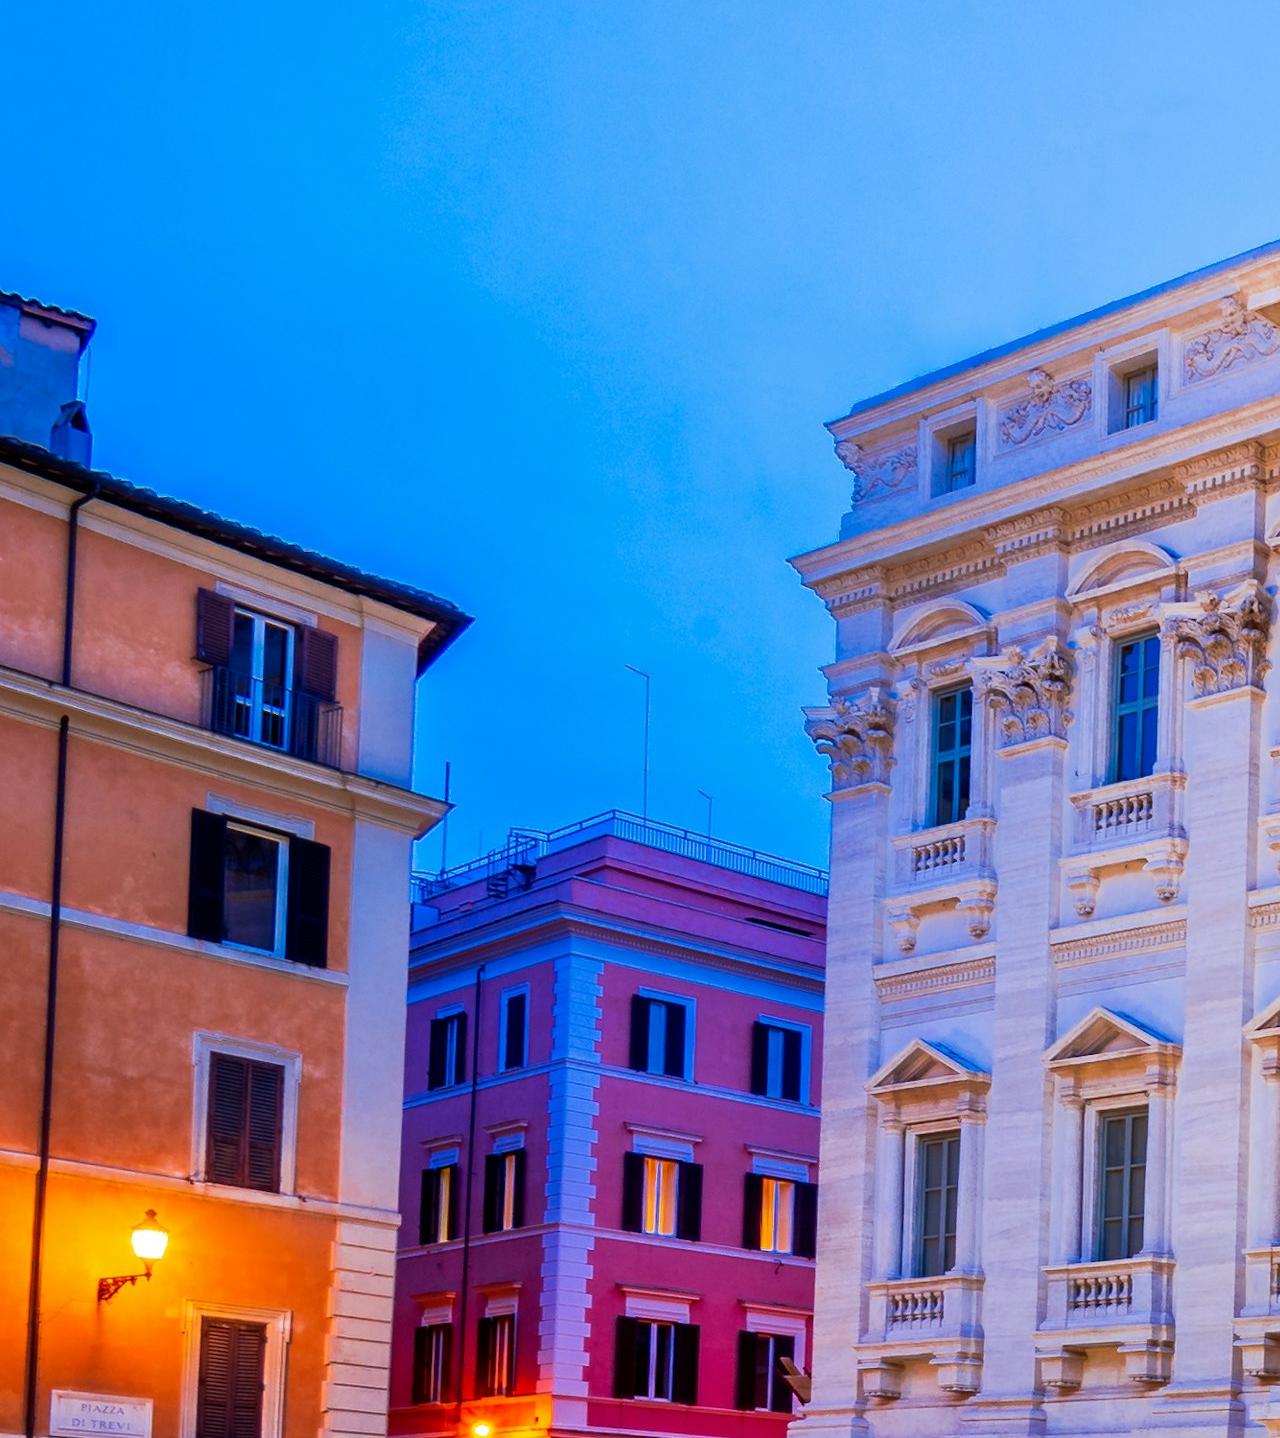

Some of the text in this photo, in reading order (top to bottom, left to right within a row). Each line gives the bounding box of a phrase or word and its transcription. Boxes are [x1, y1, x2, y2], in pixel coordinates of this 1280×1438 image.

[81, 1403, 125, 1415] PIAZZA
[71, 1418, 130, 1430] DI TREVI
